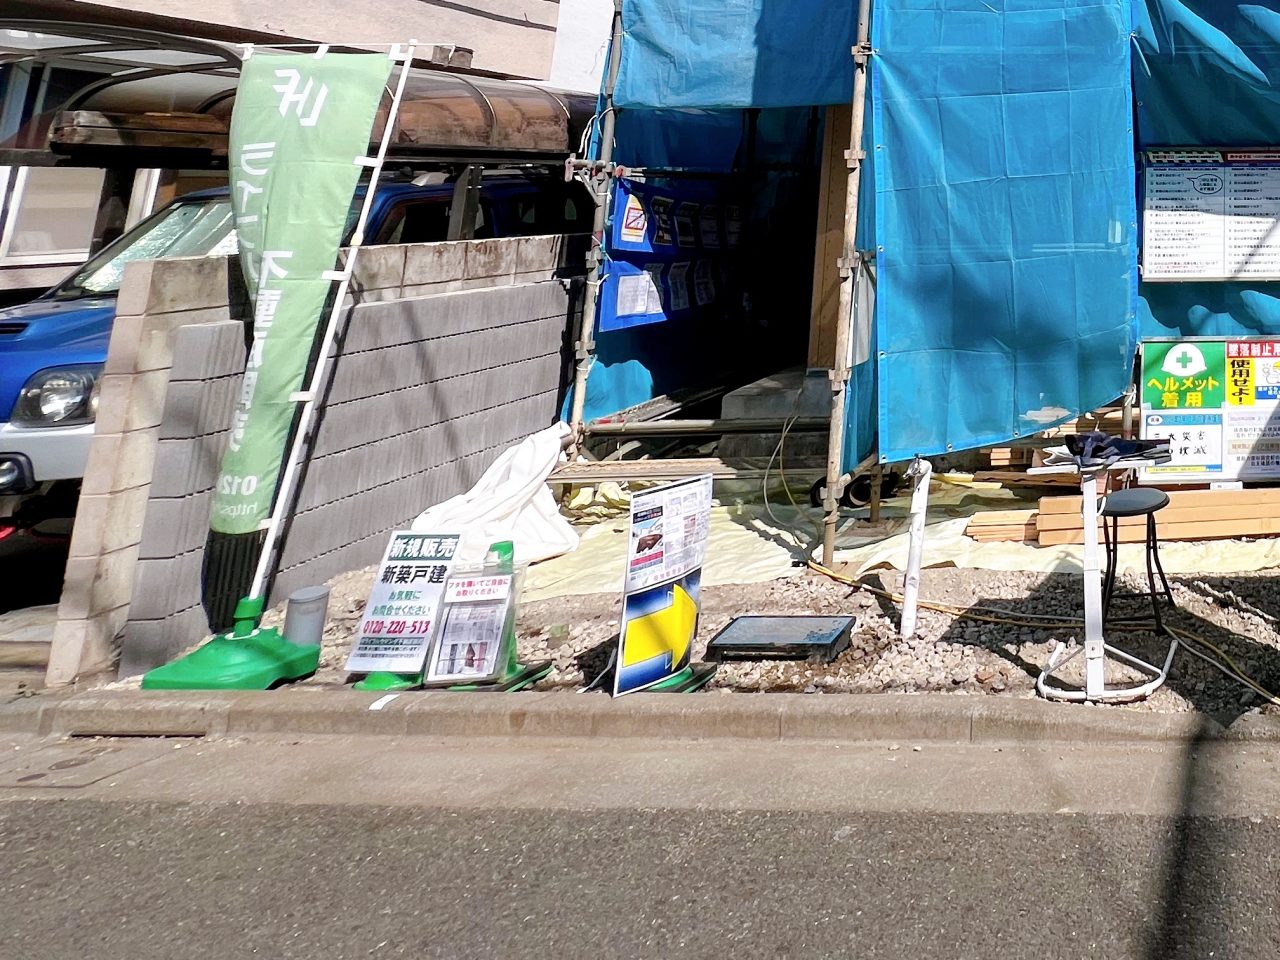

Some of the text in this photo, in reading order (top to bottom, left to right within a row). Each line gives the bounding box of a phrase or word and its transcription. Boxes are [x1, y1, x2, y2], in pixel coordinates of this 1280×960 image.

[1147, 377, 1220, 392] ヘルメット
[1161, 392, 1203, 408] 着用
[390, 537, 458, 558] 新規販売
[380, 565, 448, 584] 新築戸建
[388, 590, 422, 601] お気軽に
[371, 605, 431, 616] お問合せください
[363, 620, 431, 634] 0120-220-513
